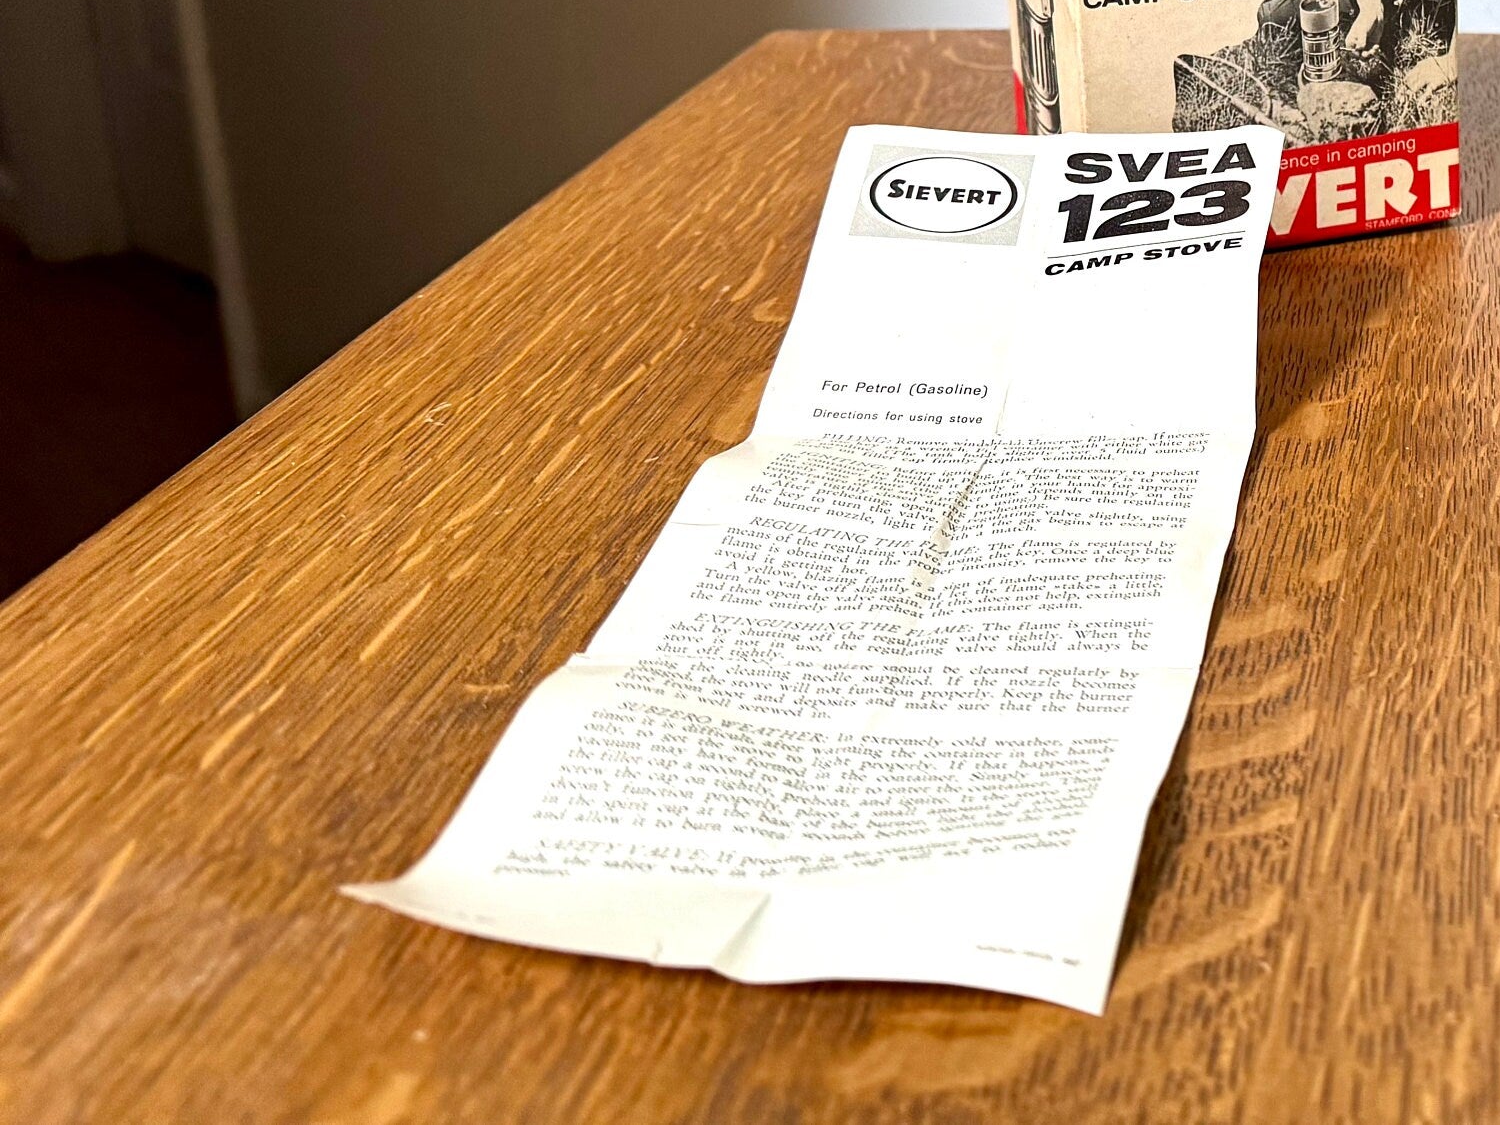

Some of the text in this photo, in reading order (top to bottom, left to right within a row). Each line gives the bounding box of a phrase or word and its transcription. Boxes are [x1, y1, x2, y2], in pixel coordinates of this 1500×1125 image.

[1064, 142, 1257, 184] SVEA
[1327, 149, 1341, 163] in
[1347, 138, 1416, 159] camping
[887, 178, 1002, 205] SIEVERT
[1058, 180, 1252, 244] 123
[1044, 236, 1243, 277] CAMP STOVE
[822, 380, 988, 399] For Petrol (Gasoline)
[812, 408, 879, 421] Directions
[885, 411, 904, 422] for
[909, 414, 943, 425] using
[1151, 469, 1200, 477] preheat
[750, 484, 891, 515] the key to turn the
[772, 479, 810, 491] After
[901, 502, 934, 513] open
[1097, 496, 1118, 504] the
[1123, 497, 1192, 509] regulating
[745, 493, 916, 531] the burner nozzle, light
[726, 526, 1175, 560] means of the regulating the Once deep blue
[749, 515, 1153, 551] REGULATING THE The flame regulated
[714, 548, 868, 576] avoid it getting hot.
[720, 534, 1151, 576] flame is obtained in the proper remove the key
[703, 567, 1047, 595] Turn the valve off slightly the flame
[744, 563, 1167, 587] yellow, blazing flame inadequate preheating.
[690, 589, 925, 619] the flame entirely and preheat
[695, 580, 1162, 610] and then open the valve again. not extinguish
[694, 612, 1155, 634] EXTINGUISHING THE The flame is extingui-
[733, 638, 1149, 657] not the regulating valve should always be
[739, 627, 1152, 648] shutting off the regulating valve tightly. When the
[946, 675, 964, 687] If
[973, 676, 999, 687] the
[1009, 677, 1061, 688] nozzle
[1071, 677, 1137, 690] becomes
[969, 665, 1140, 681] cleaned regularly by
[999, 699, 1034, 712] that
[1041, 701, 1067, 713] the
[1075, 701, 1131, 713] burner
[1002, 687, 1043, 703] Keep
[1049, 689, 1075, 701] the
[1079, 689, 1134, 702] burner
